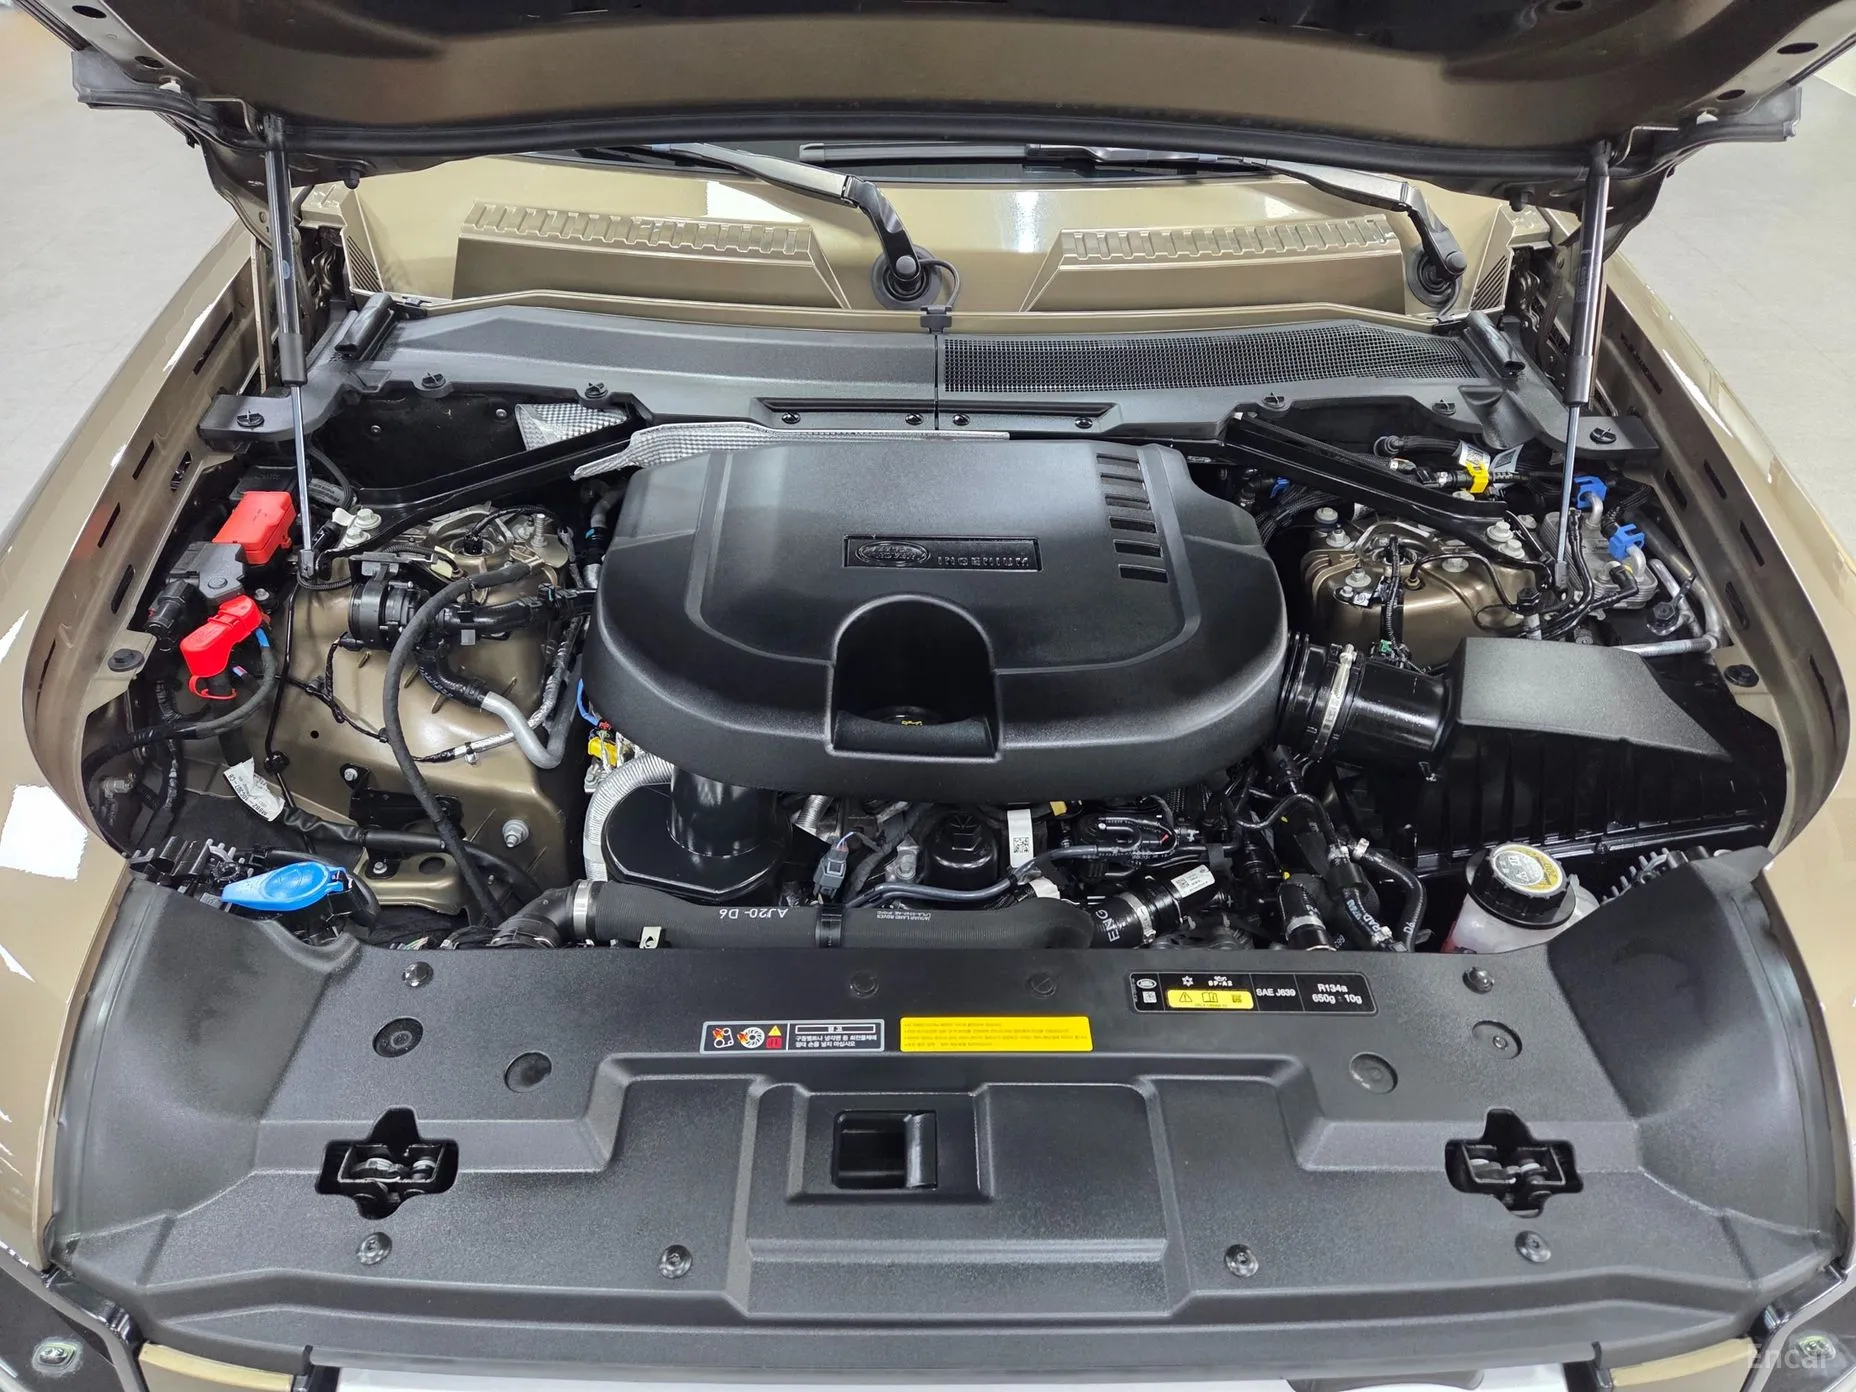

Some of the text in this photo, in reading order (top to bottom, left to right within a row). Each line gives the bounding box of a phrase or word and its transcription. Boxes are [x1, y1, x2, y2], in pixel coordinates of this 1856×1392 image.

[937, 555, 1029, 567] INGENIUM
[719, 908, 739, 919] D6
[1095, 909, 1120, 943] ENG
[1363, 914, 1381, 933] RAD
[1256, 988, 1275, 997] SAE
[1317, 983, 1349, 993] R134a
[1311, 993, 1336, 1005] 650g
[1344, 994, 1363, 1005] 10g
